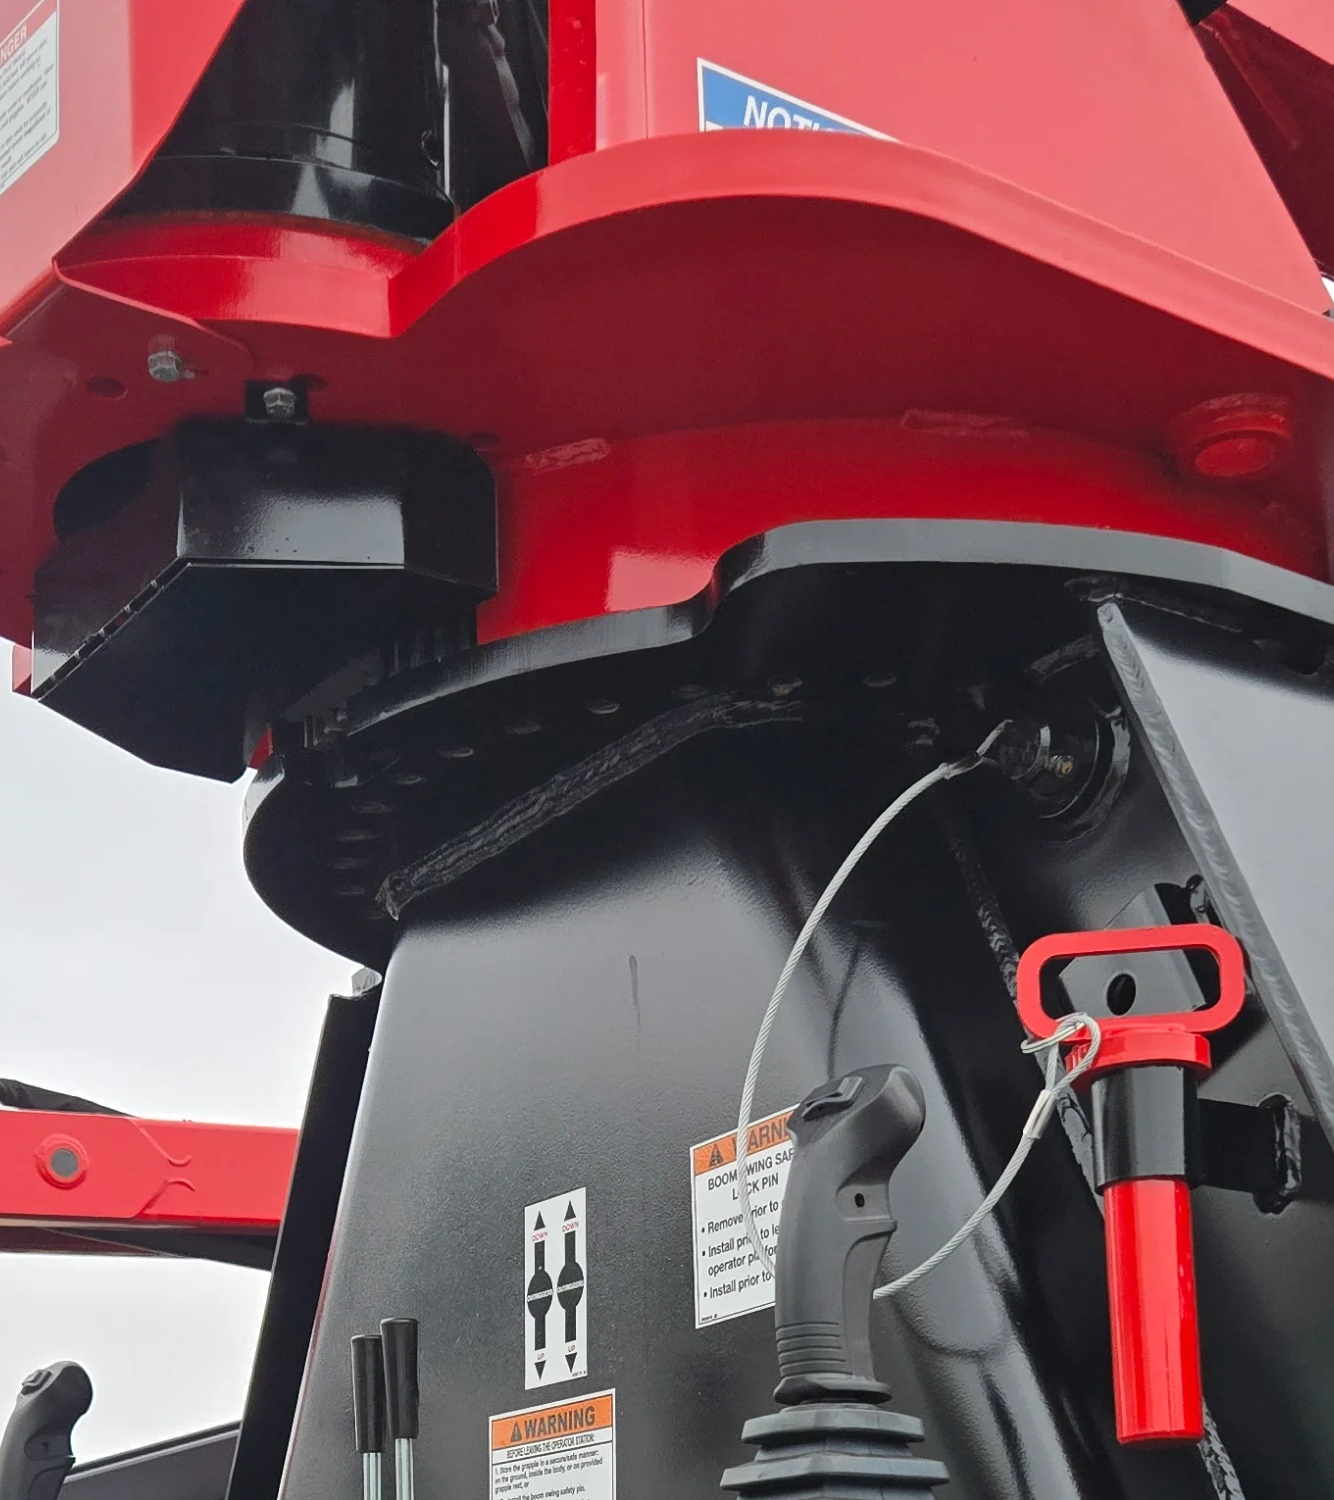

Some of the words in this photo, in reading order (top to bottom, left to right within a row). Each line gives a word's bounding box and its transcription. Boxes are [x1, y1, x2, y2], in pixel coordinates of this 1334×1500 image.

[708, 1169, 737, 1190] BOOM
[746, 1156, 773, 1177] WING
[775, 1148, 795, 1165] SAF
[733, 1182, 759, 1200] LCK
[762, 1173, 779, 1193] PIN
[708, 1213, 744, 1234] Remove
[751, 1204, 767, 1218] rior
[770, 1201, 779, 1213] to
[532, 1232, 548, 1242] DOWN
[562, 1221, 579, 1232] DOWN
[709, 1238, 734, 1257] Install
[760, 1228, 769, 1240] to
[708, 1255, 751, 1276] operator
[710, 1280, 736, 1298] Install
[739, 1274, 760, 1295] prior
[762, 1268, 772, 1285] to
[525, 1406, 595, 1439] WARNING
[506, 1447, 523, 1459] BEFORE
[524, 1443, 542, 1456] LEAVING
[542, 1440, 551, 1451] THE
[551, 1437, 575, 1450] OPERATOR
[500, 1465, 511, 1474] Store
[521, 1459, 539, 1473] grapple
[510, 1471, 528, 1483] ground,
[529, 1468, 543, 1478] inside
[544, 1467, 552, 1475] the
[573, 1461, 580, 1470] on
[581, 1458, 603, 1471] provided
[495, 1482, 511, 1494] grapple
[531, 1491, 544, 1500] boom
[545, 1489, 560, 1498] swing
[560, 1486, 575, 1498] safety
